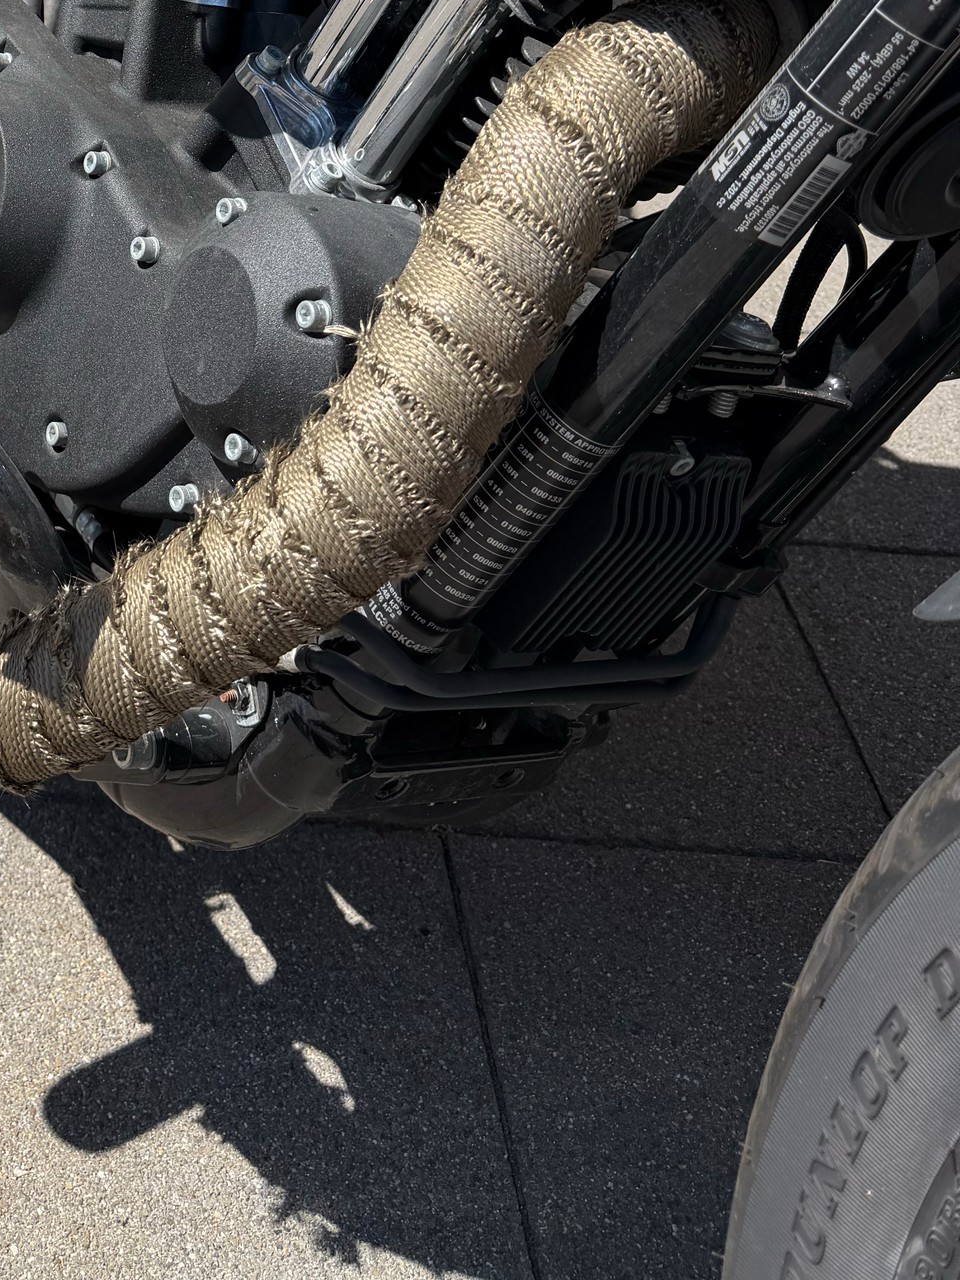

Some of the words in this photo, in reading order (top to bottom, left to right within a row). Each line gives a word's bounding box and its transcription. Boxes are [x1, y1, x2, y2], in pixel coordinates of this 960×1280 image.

[890, 31, 904, 45] 95
[856, 51, 870, 65] 34
[869, 42, 893, 68] dB(A)
[846, 62, 861, 79] kW
[851, 69, 872, 92] 2625
[780, 100, 807, 130] Engine
[797, 109, 816, 130] GSO
[790, 115, 823, 153] conforms
[815, 122, 834, 138] The
[709, 129, 750, 181] USW
[738, 127, 785, 181] Displacement:
[762, 126, 800, 171] motorcycle
[781, 133, 820, 180] motorcycle
[783, 151, 794, 162] to
[774, 160, 786, 173] all
[723, 179, 742, 200] 1202
[727, 168, 765, 211] regulations.
[743, 169, 778, 209] applicable
[759, 181, 782, 207] motor
[715, 196, 726, 208] cc
[733, 202, 764, 233] tricycle,
[540, 408, 575, 440] SYSTEM
[502, 461, 519, 479] 39R
[487, 479, 504, 497] 41R
[473, 495, 489, 513] 53R
[382, 602, 395, 619] kPa
[390, 600, 403, 616] kPa
